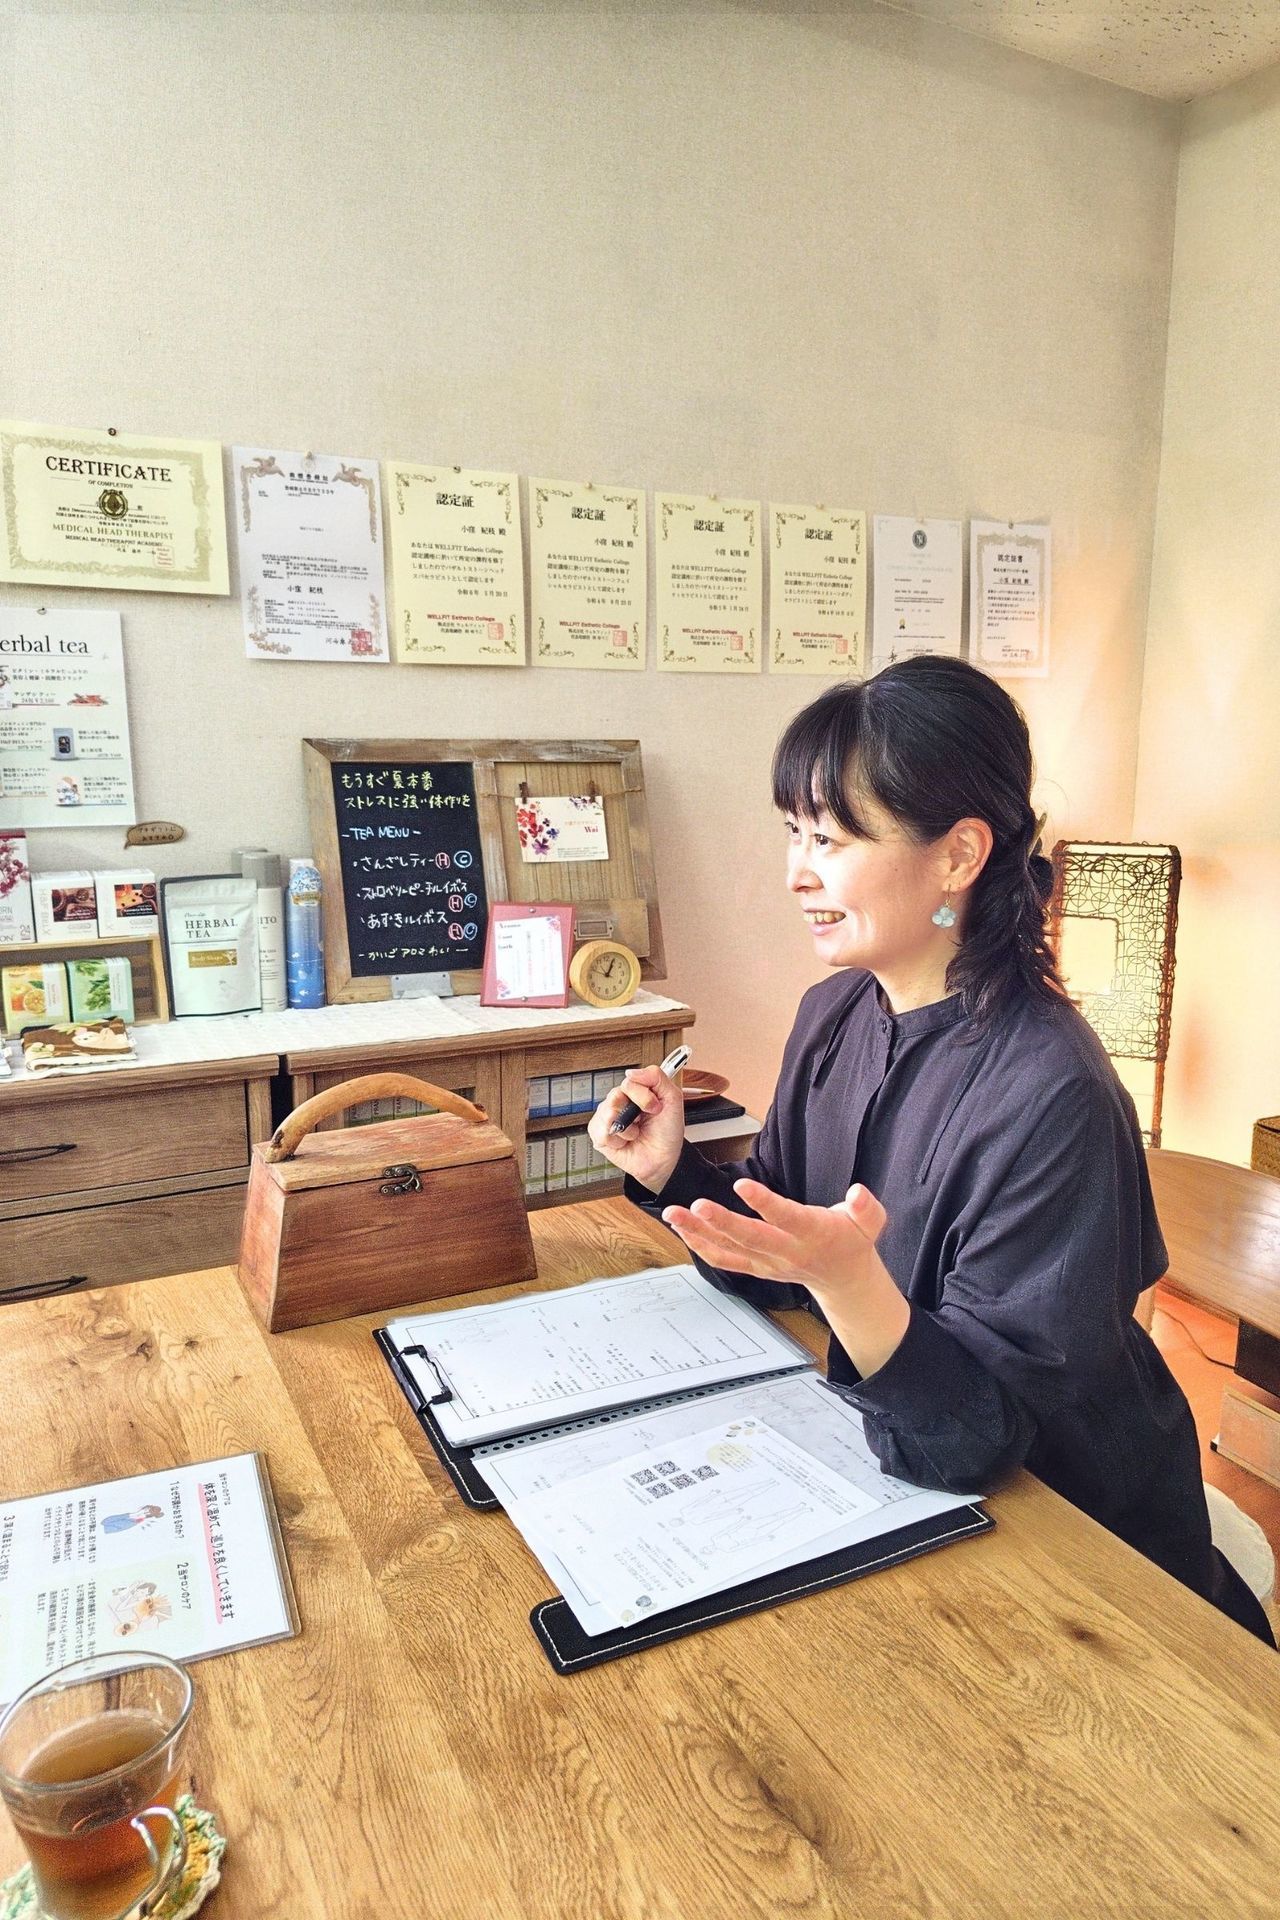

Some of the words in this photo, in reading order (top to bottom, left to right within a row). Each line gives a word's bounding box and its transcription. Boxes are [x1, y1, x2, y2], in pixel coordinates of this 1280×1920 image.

[45, 456, 172, 482] CERTIFICATE
[97, 480, 133, 489] COMPLETION
[436, 491, 475, 508] 認定証
[571, 506, 606, 521] 認定証
[52, 523, 94, 534] MEDICAL
[97, 527, 123, 536] HEAD
[125, 530, 173, 541] THERAPIST
[694, 519, 725, 532] 認定証
[805, 528, 834, 541] 認定証
[0, 634, 51, 653] erbal
[59, 640, 89, 653] tea
[341, 771, 433, 791] もうすぐ夏本番
[344, 794, 471, 809] ストレスに強い体作りを
[349, 827, 374, 840] TEA
[378, 826, 410, 838] MENU
[184, 919, 238, 930] HERBAL
[187, 930, 211, 938] TEA
